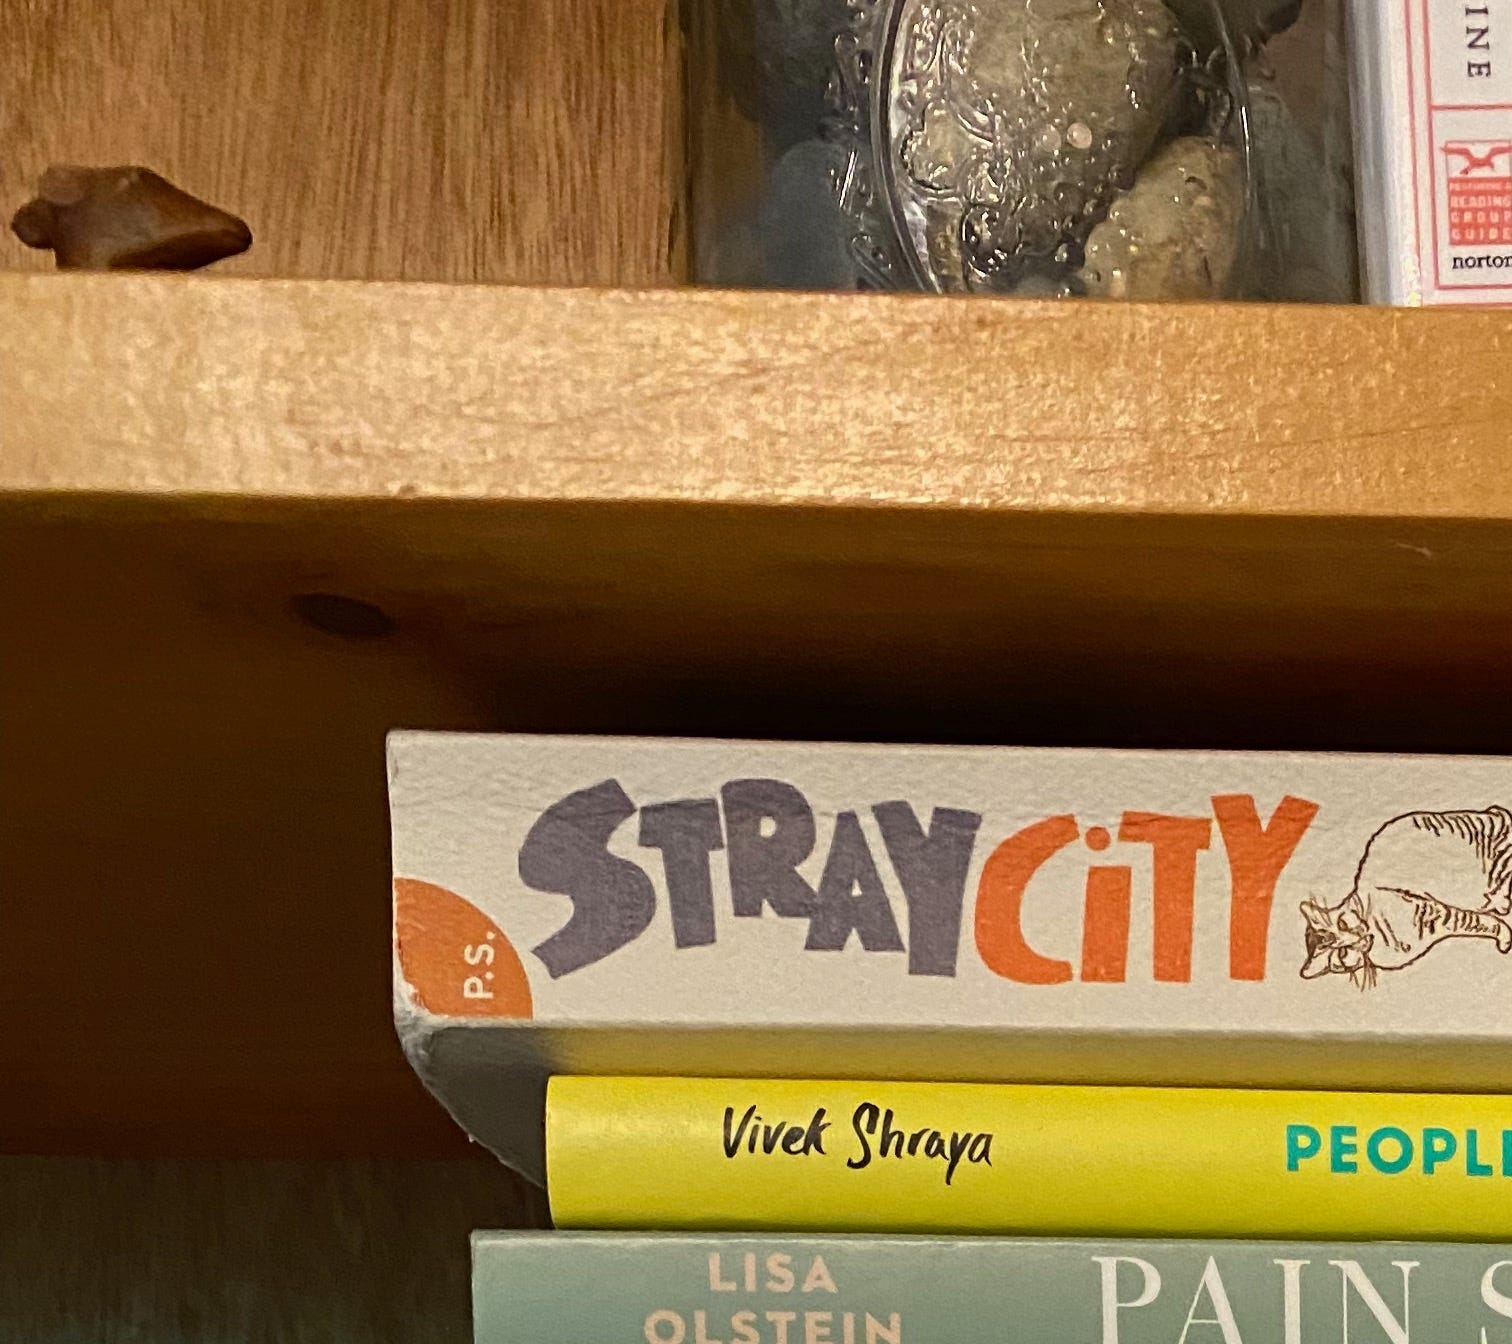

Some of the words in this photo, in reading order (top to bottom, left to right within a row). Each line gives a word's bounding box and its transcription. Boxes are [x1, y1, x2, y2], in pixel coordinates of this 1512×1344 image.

[518, 777, 982, 979] STRAY
[464, 930, 497, 999] P.S.
[722, 1105, 829, 1158] Vivek
[847, 1102, 993, 1185] Shraya
[708, 1253, 838, 1294] LISA
